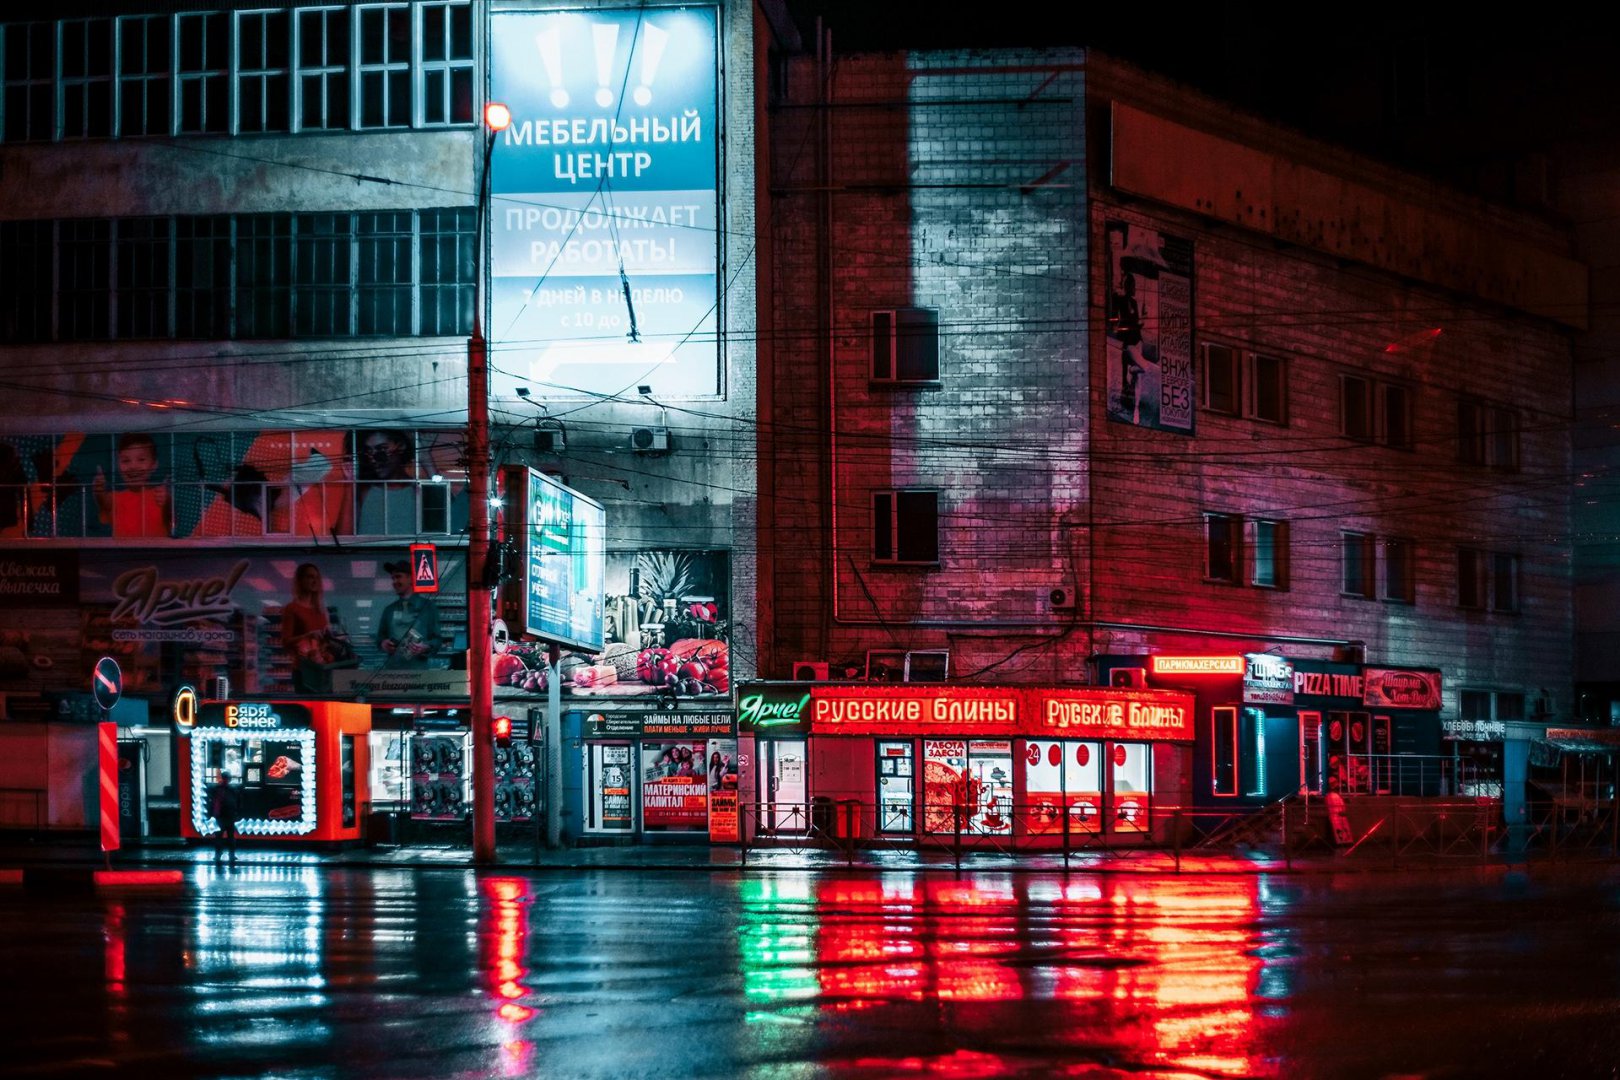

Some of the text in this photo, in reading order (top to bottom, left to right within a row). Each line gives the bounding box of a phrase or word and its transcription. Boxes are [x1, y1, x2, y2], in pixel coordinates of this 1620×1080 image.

[504, 110, 701, 146] МЕБЕЛЬНЫЙ
[554, 152, 652, 183] ЦЕНТР
[504, 205, 700, 235] ПРОДОЛЖАЕТ
[530, 238, 676, 265] РАБОТАТЬ!
[537, 284, 586, 307] ДНЕЙ
[591, 288, 602, 304] В
[575, 312, 594, 327] 10
[597, 315, 621, 330] до
[623, 311, 646, 327] 0
[1161, 356, 1190, 378] ВНЖ
[1161, 384, 1190, 410] БЕЗ
[110, 557, 251, 624] Ярче!
[113, 631, 137, 641] сеть
[138, 627, 196, 641] магазинов
[205, 631, 233, 642] дома
[1159, 658, 1236, 670] ПАРИКМАХЕРСКАЯ
[1294, 671, 1363, 698] PIZZA TIME
[644, 713, 731, 725] ЗАЙМЫ НА ЛЮБЫЕ ЦЕЛИ
[738, 693, 811, 727] Ярче!
[1028, 748, 1040, 763] 24
[121, 782, 133, 817] pepsi
[644, 782, 707, 796] МАТЕРИНСКИЙ
[644, 796, 684, 808] КАПИТАЛ
